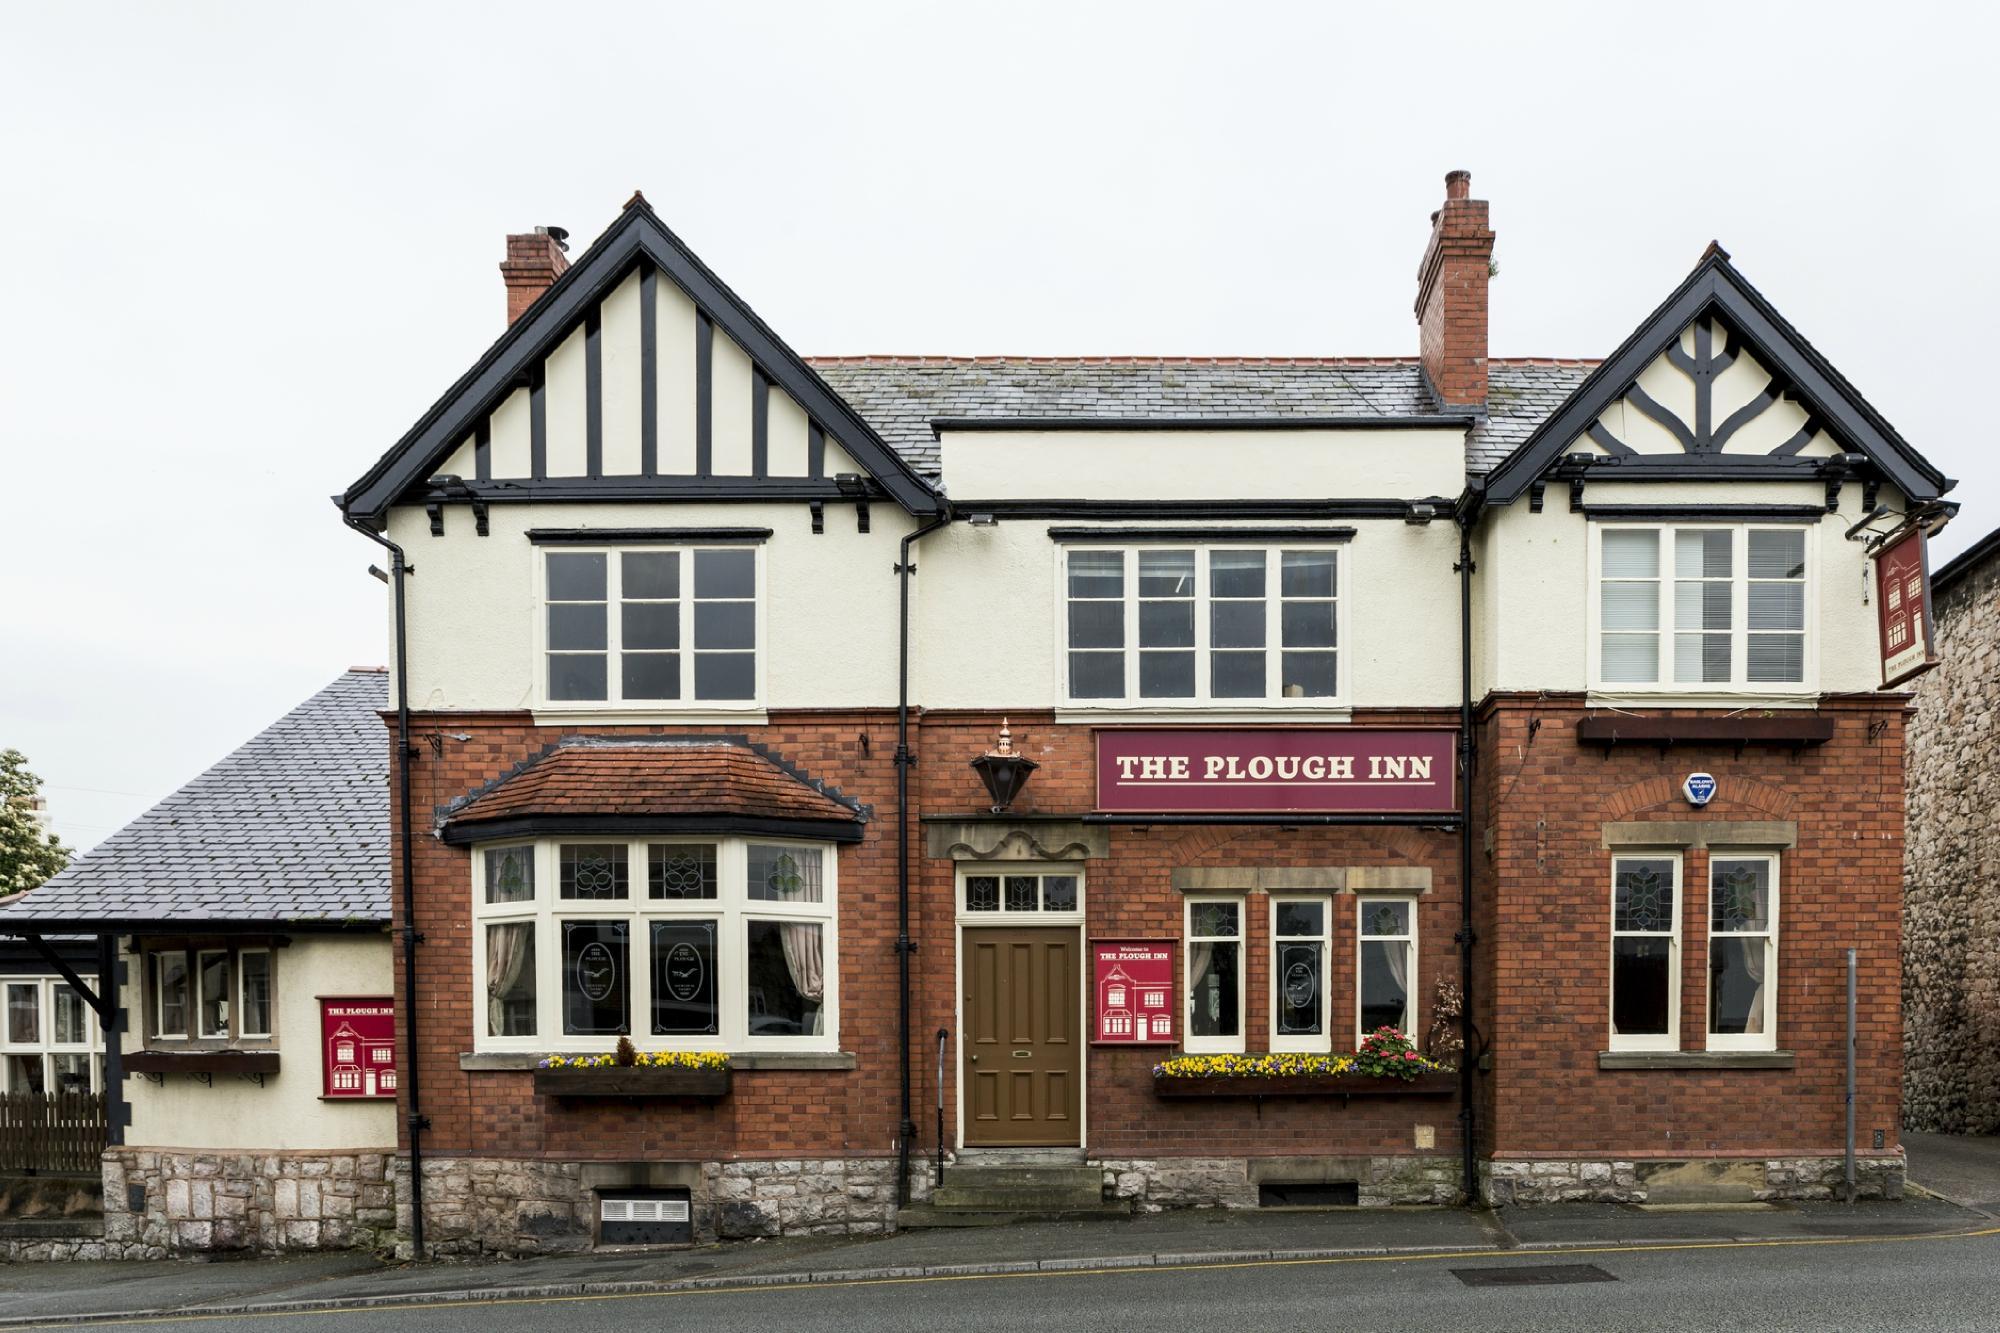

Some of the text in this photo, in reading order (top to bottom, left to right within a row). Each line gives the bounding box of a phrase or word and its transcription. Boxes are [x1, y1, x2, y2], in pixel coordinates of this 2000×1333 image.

[1116, 756, 1433, 779] THE PLOUGH INN
